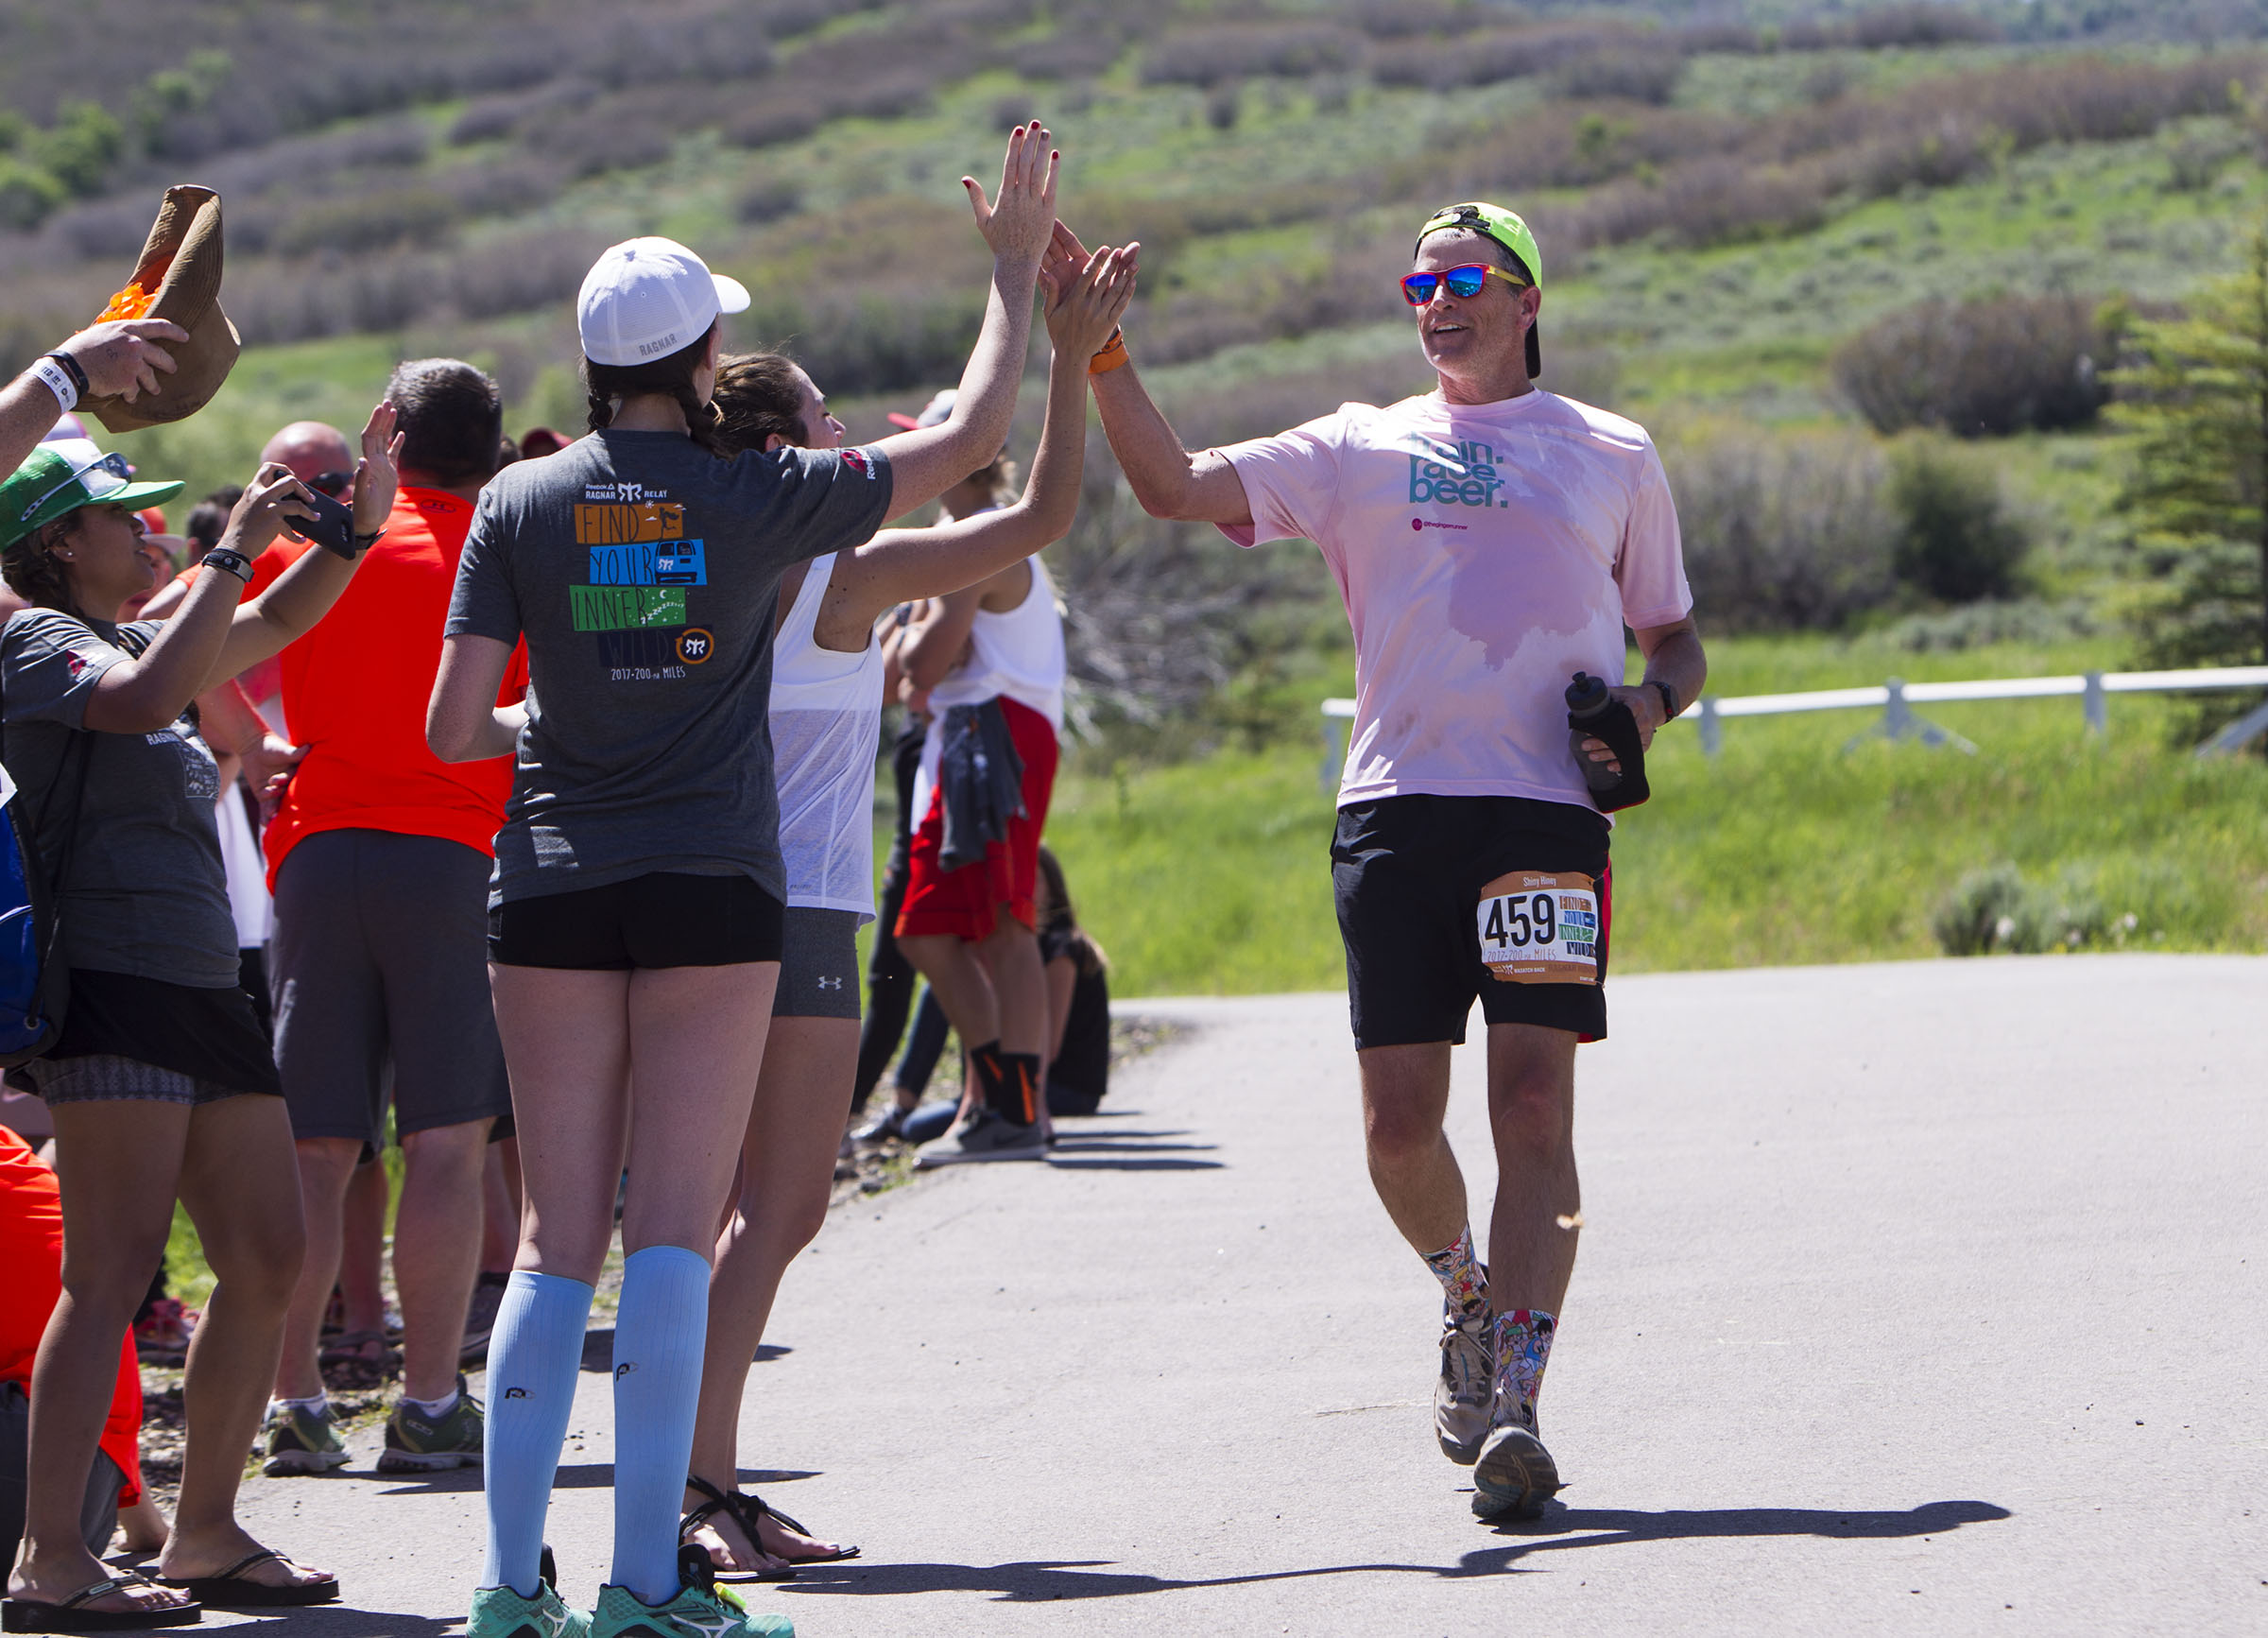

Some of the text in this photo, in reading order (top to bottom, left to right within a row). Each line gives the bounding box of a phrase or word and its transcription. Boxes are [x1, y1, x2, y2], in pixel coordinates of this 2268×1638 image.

[638, 333, 678, 356] RAGNAR
[585, 490, 668, 500] RAGNAR RELAY
[1409, 477, 1508, 508] beer.
[584, 506, 639, 543] FIND
[590, 545, 654, 584] YOUR
[576, 588, 647, 630] INNER
[662, 665, 686, 679] MILES
[1561, 896, 1581, 909] FIND
[1485, 893, 1556, 948] 459
[1534, 948, 1556, 960] MILES
